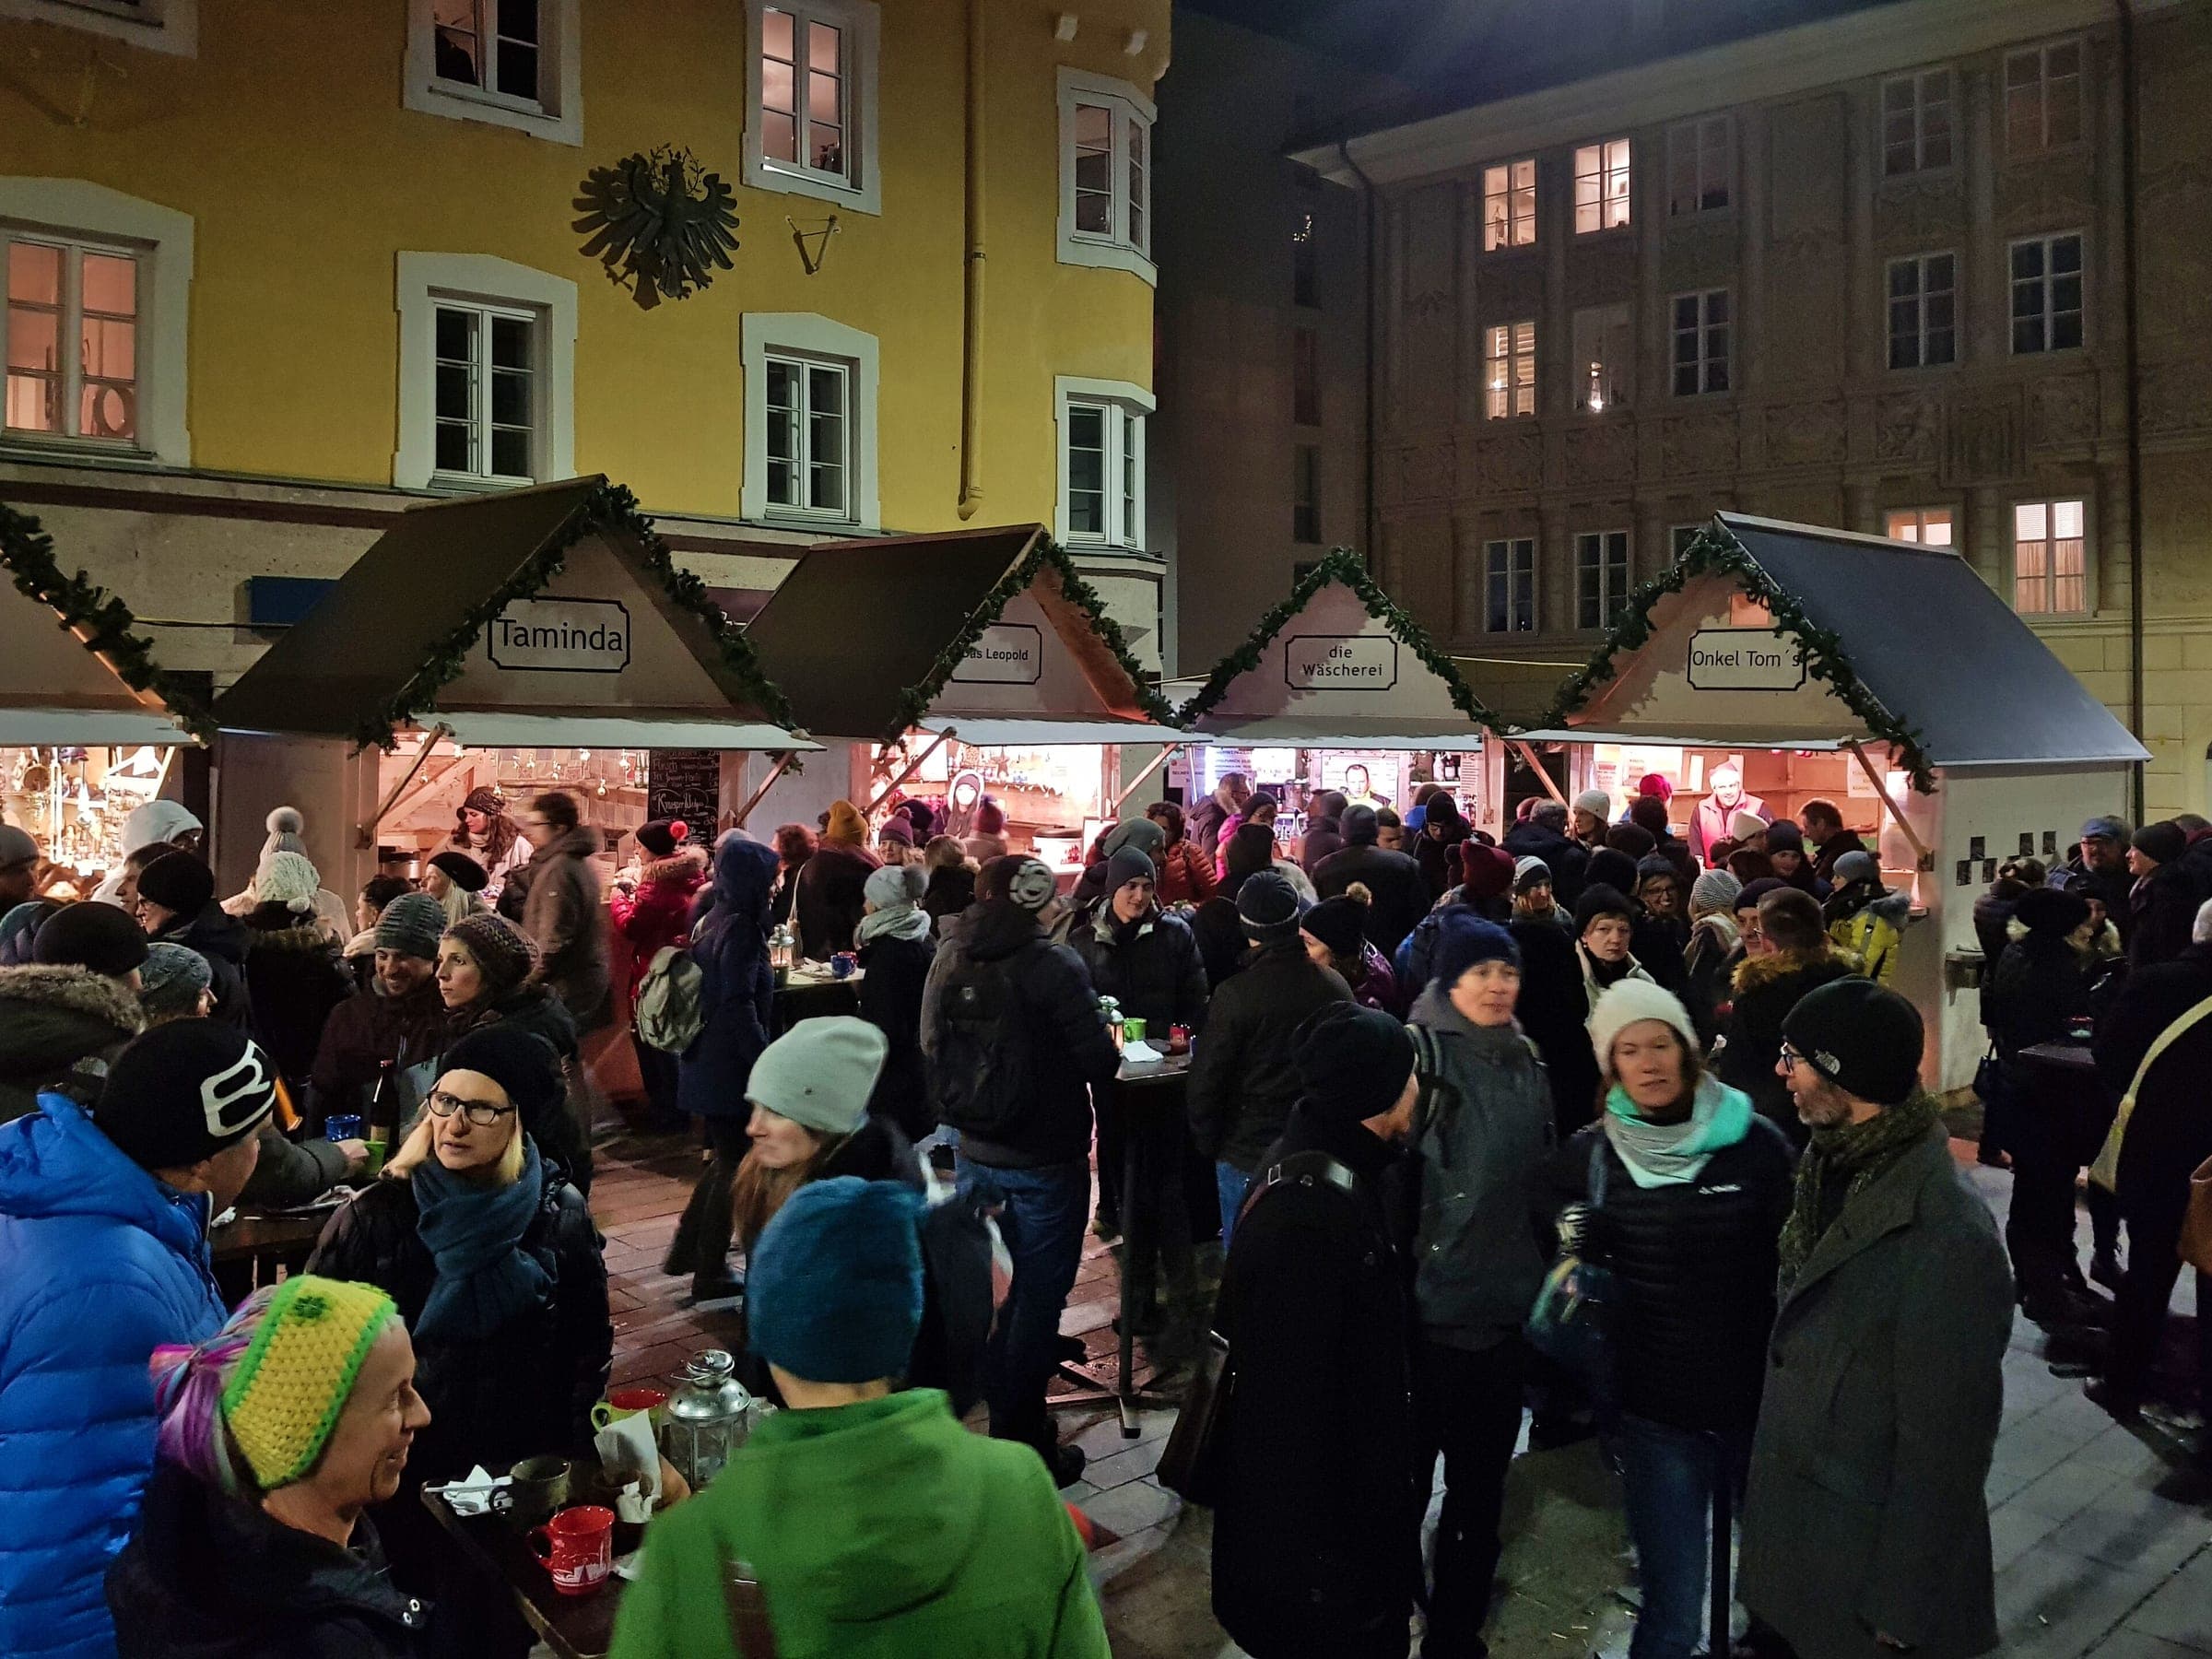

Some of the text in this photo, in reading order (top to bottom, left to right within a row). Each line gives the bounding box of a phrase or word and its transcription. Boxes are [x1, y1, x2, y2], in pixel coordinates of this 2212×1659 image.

[496, 618, 623, 651] Taminda
[986, 648, 1029, 662] Leopold
[1329, 646, 1353, 658] die
[1692, 650, 1740, 666] Onkel
[1302, 663, 1382, 677] Wäscherei
